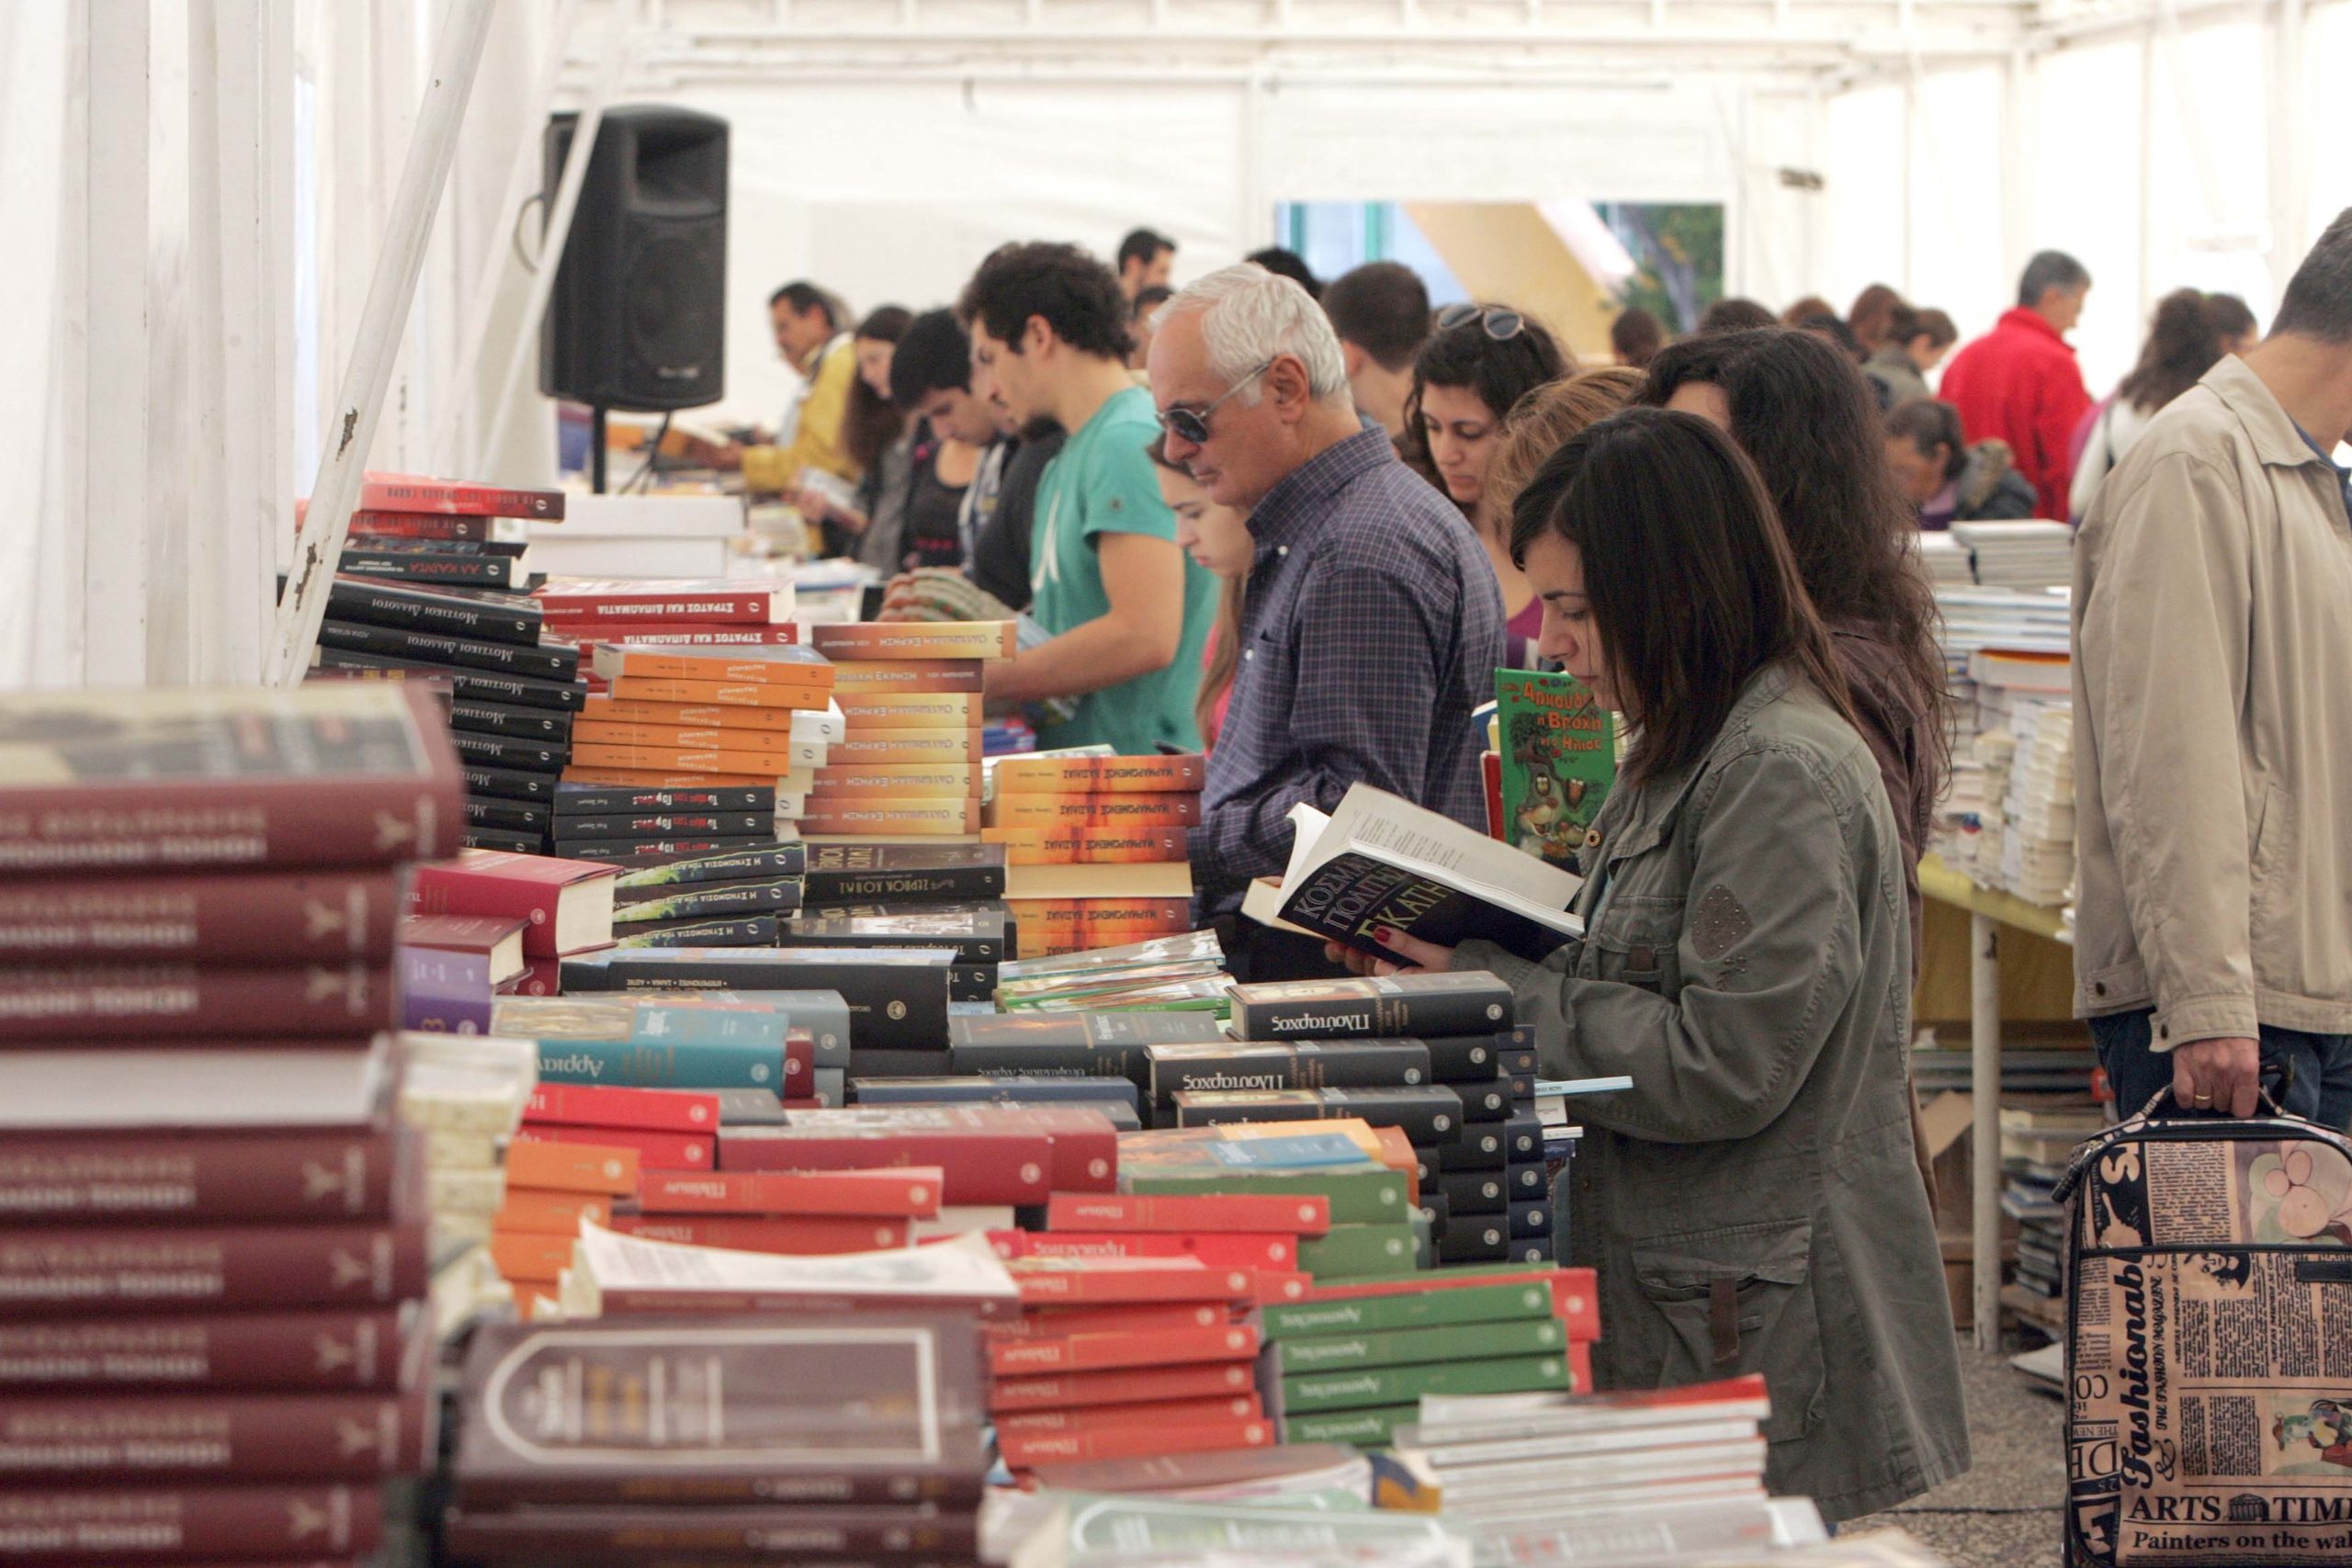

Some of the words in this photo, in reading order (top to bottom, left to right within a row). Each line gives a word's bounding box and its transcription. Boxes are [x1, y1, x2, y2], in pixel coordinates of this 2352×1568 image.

[666, 604, 685, 615] ΚΑΙ
[686, 603, 734, 614] ΣΤΡΑΤΟΣ
[1272, 1011, 1371, 1034] Πλούταρχος
[2097, 1426, 2119, 1437] THE
[2128, 1495, 2222, 1522] ARTS
[2273, 1495, 2352, 1522] TIM
[2132, 1530, 2231, 1551] Painters
[2235, 1535, 2266, 1549] on
[2272, 1530, 2310, 1549] the
